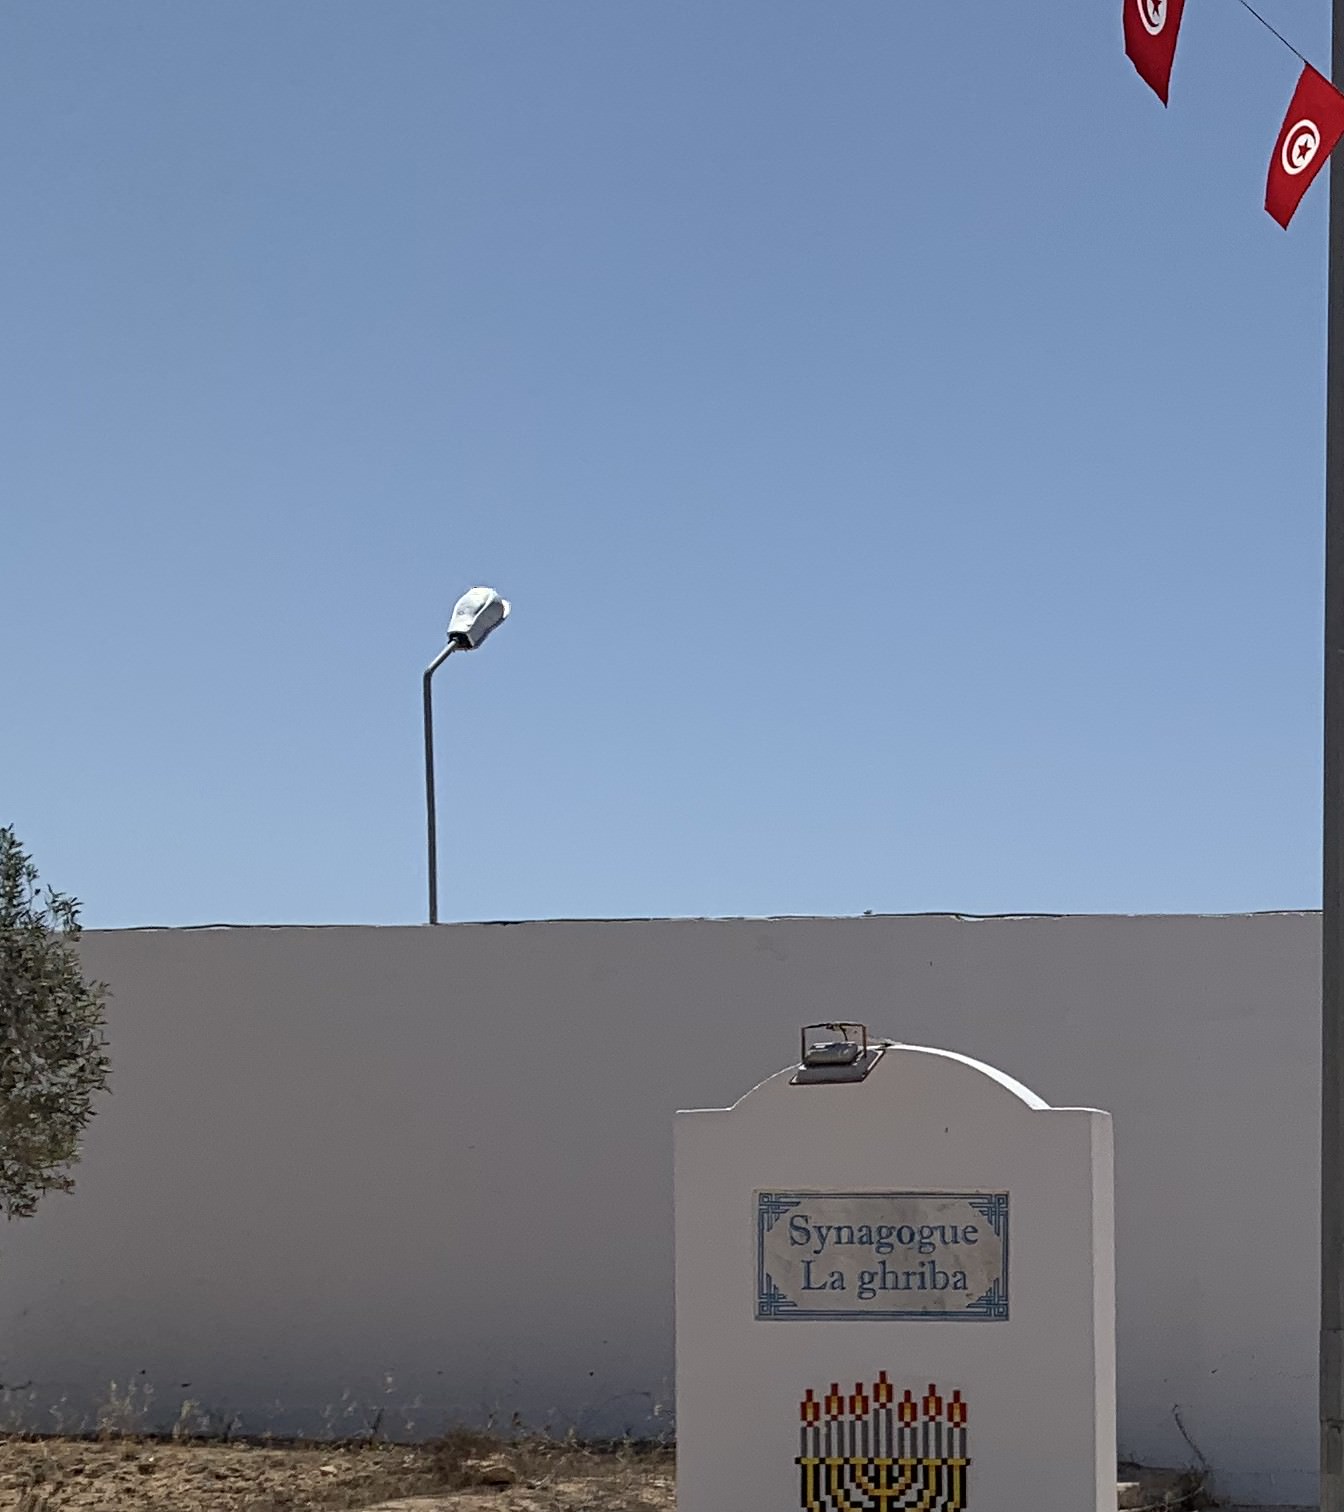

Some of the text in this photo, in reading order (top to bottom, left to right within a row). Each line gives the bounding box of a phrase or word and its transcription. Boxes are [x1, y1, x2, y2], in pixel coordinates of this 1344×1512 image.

[789, 1215, 979, 1254] Synagogue
[801, 1260, 968, 1300] La ghriba
